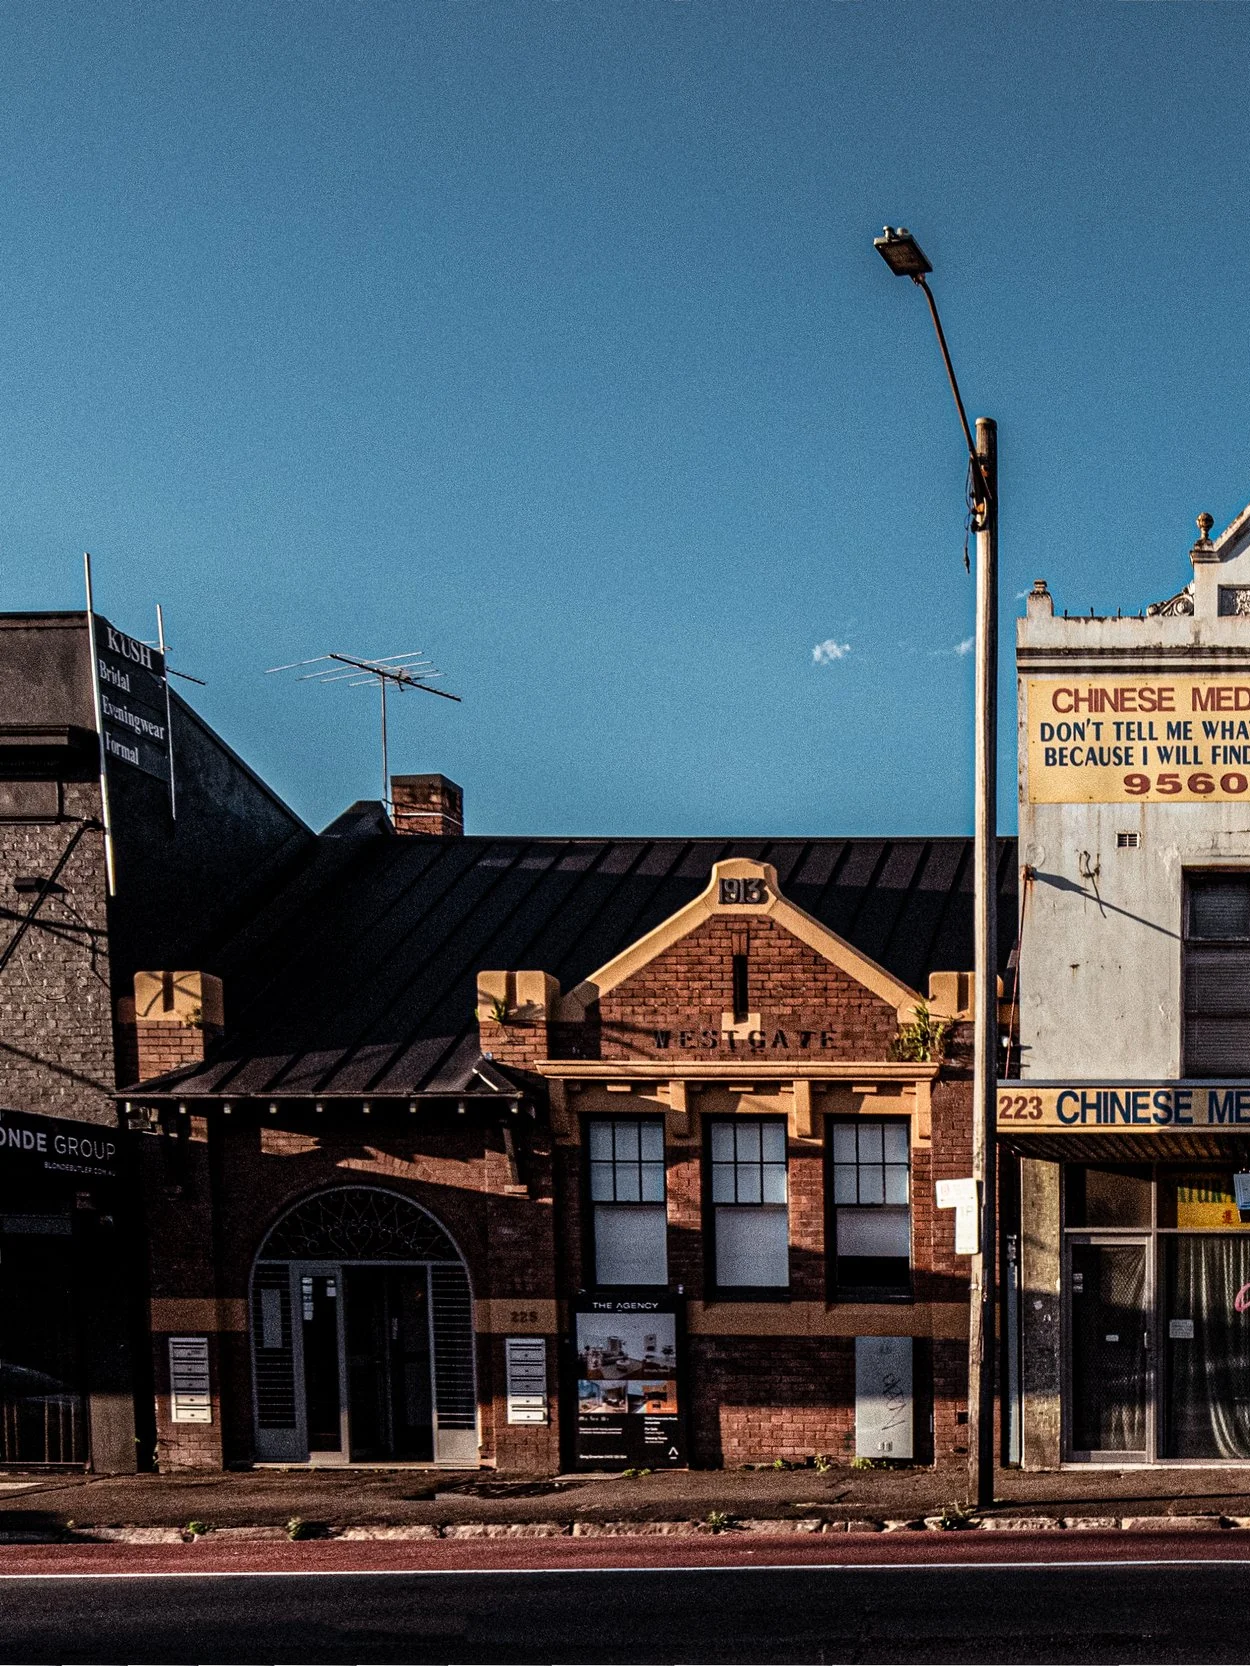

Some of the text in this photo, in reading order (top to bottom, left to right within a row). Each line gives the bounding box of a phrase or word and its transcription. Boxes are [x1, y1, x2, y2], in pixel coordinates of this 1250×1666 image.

[106, 626, 153, 670] KUSH
[98, 658, 131, 693] Bridal
[1051, 687, 1176, 713] CHINESE
[101, 694, 165, 741] Eveningwear
[1040, 718, 1104, 742] DON'T
[1112, 720, 1158, 742] TELL
[1166, 720, 1193, 741] ME
[105, 731, 140, 766] Formal
[1044, 746, 1135, 767] BECAUSE
[1142, 746, 1148, 765] I
[1157, 745, 1203, 765] WILL
[1123, 772, 1249, 795] 9560
[719, 878, 763, 904] 1913
[652, 1028, 838, 1052] WESTGATE
[998, 1095, 1044, 1120] 223
[1055, 1089, 1194, 1124] CHINESE
[53, 1134, 117, 1161] GROUP
[510, 1311, 539, 1323] 225
[592, 1301, 660, 1312] THE AGENCY
